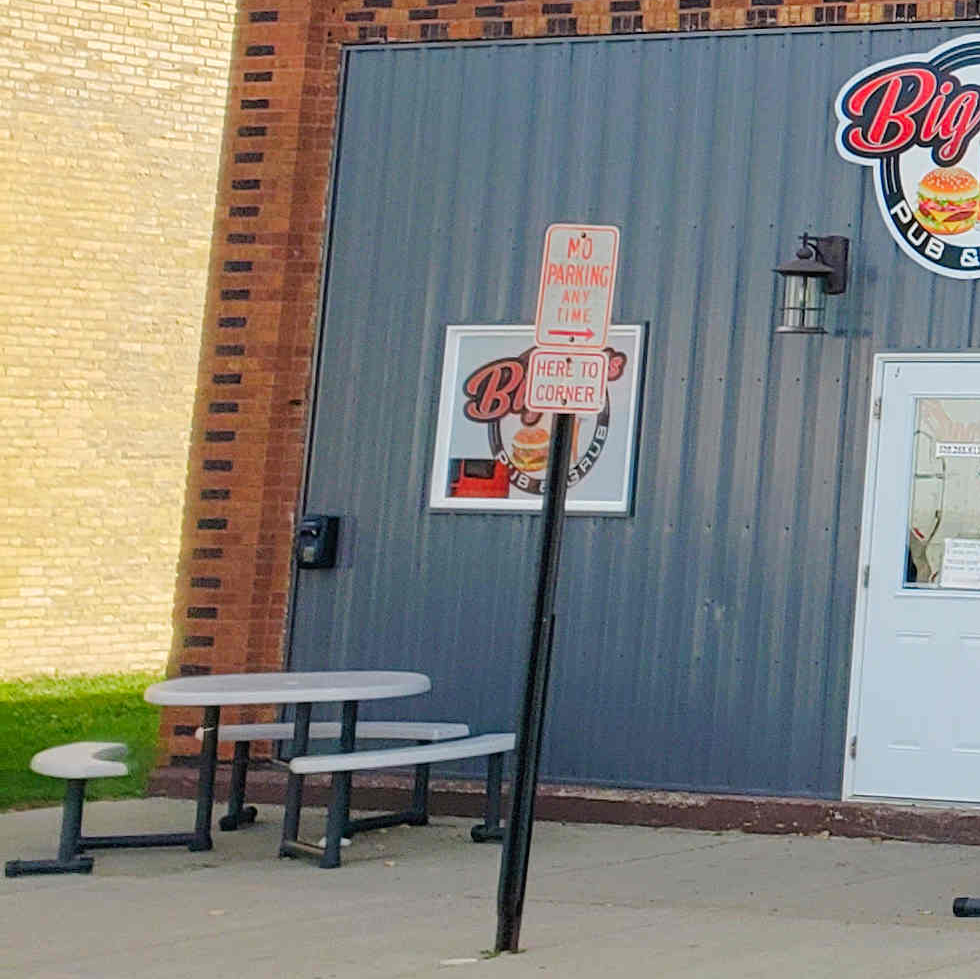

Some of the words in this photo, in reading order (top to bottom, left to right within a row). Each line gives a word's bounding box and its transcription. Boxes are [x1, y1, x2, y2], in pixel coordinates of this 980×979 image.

[889, 200, 946, 261] PUB
[959, 248, 980, 268] &
[567, 237, 593, 261] NO
[547, 264, 610, 288] PARKING
[561, 289, 592, 306] ANY
[556, 307, 593, 325] TIME
[536, 359, 573, 378] HERE
[580, 361, 599, 380] TO
[466, 360, 543, 424] Bi
[535, 384, 595, 403] CORNER
